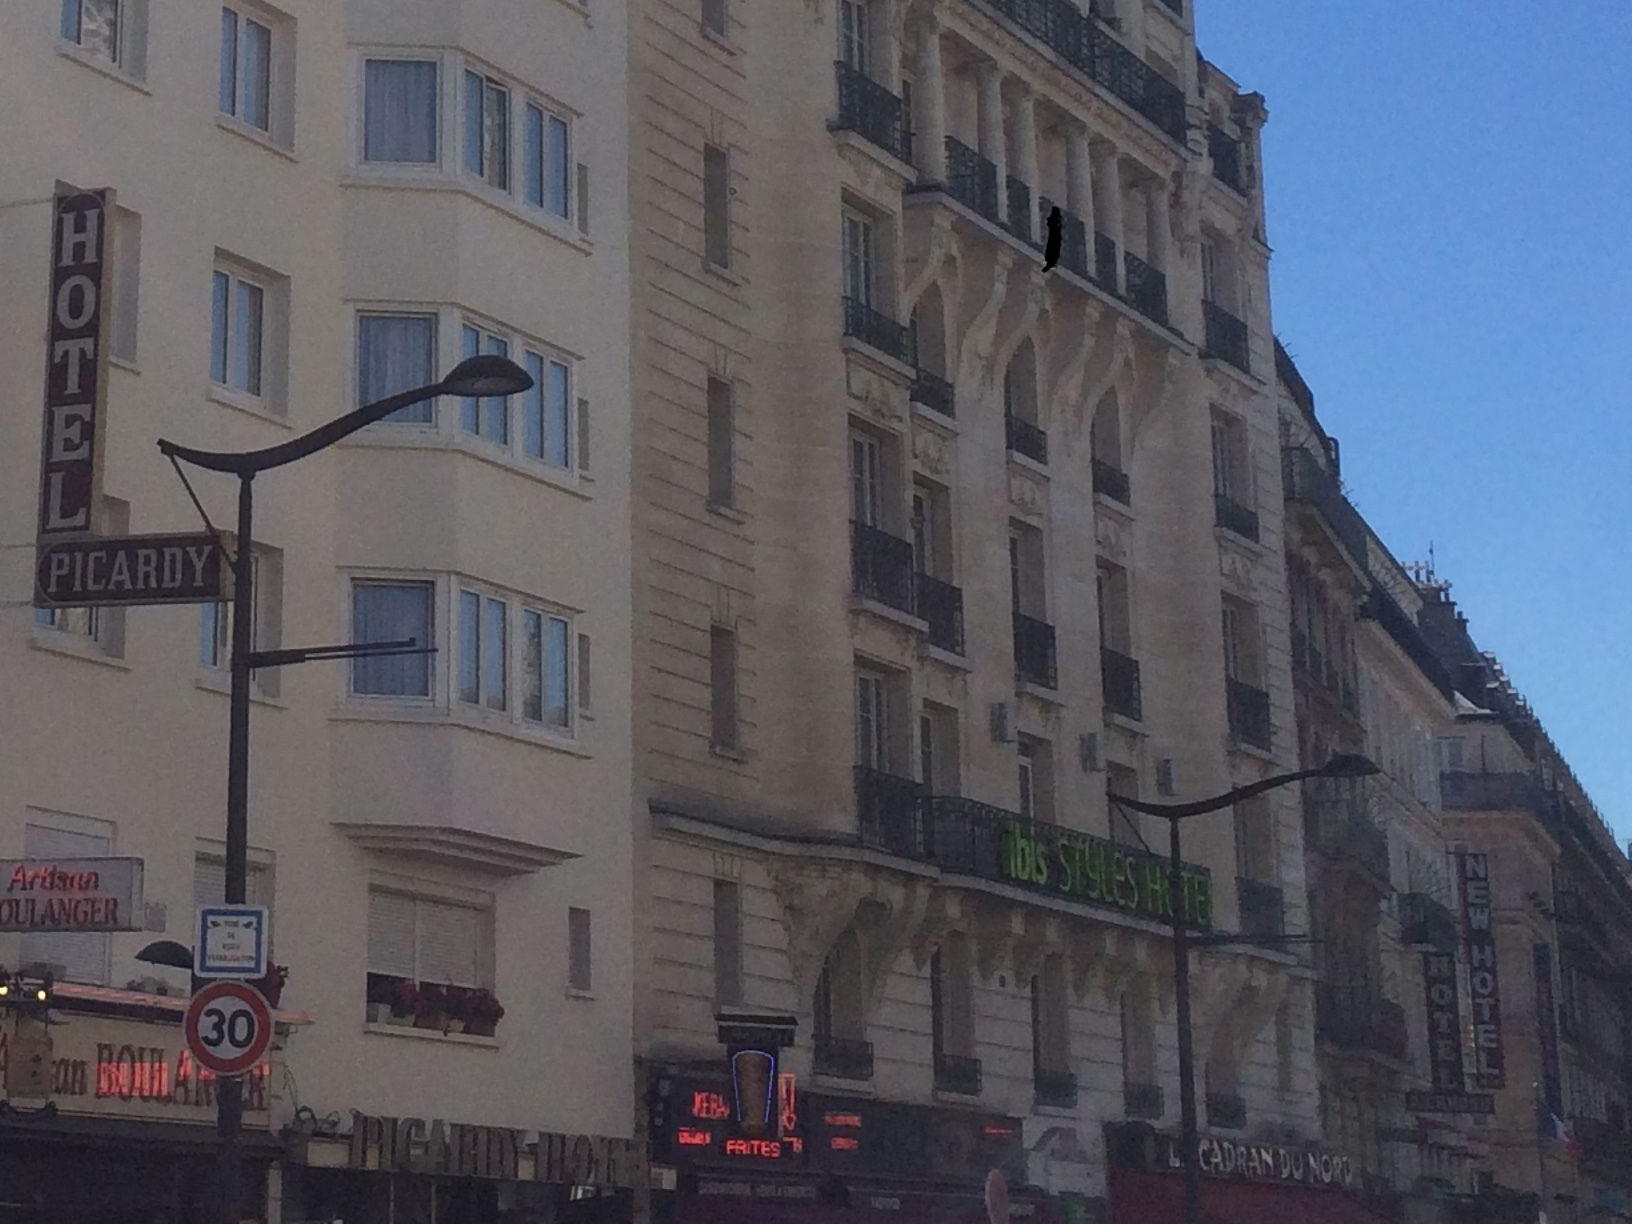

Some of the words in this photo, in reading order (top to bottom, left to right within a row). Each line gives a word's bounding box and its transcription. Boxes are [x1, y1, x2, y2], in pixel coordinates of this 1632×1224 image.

[47, 208, 98, 530] HOTEL
[47, 544, 214, 595] PICARDY
[1465, 854, 1492, 930] NEW
[200, 1007, 255, 1049] 30
[1471, 942, 1500, 1075] HOTEL
[724, 1138, 782, 1158] FRITES
[1198, 1138, 1274, 1178] CADRAN
[1279, 1147, 1304, 1180] DU
[1307, 1151, 1353, 1186] NORD
